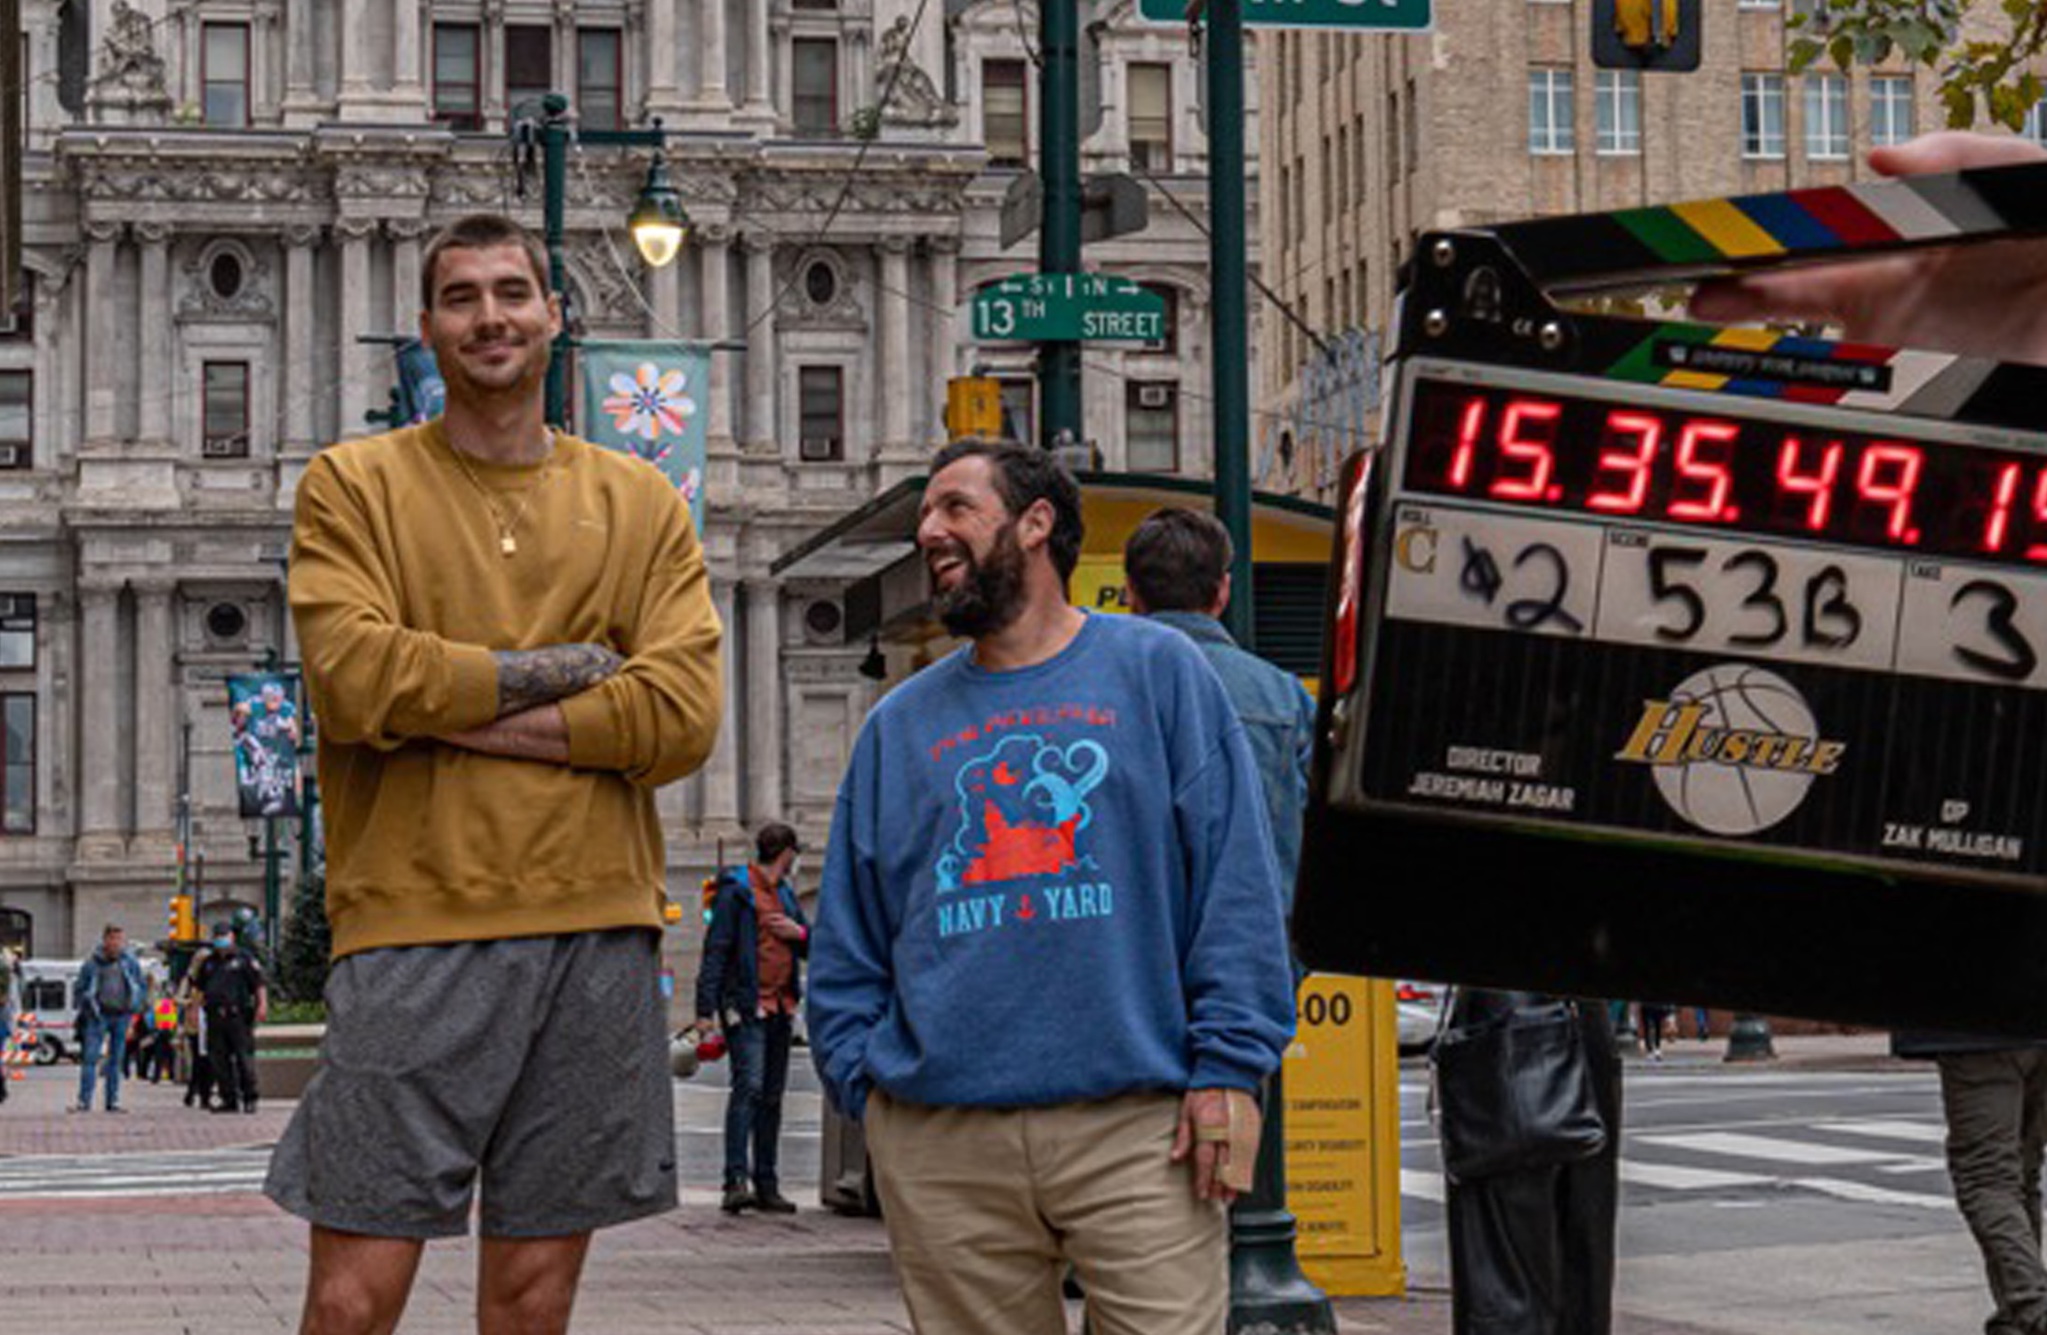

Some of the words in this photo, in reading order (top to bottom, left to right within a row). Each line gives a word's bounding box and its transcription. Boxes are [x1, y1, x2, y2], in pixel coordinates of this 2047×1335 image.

[1082, 311, 1160, 337] STREET
[1395, 527, 1438, 575] C
[1647, 546, 1862, 649] 53B
[1949, 579, 2037, 681] 3
[1446, 745, 1543, 777] DIRECTOR
[1408, 771, 1504, 804] JEREMIAH
[1507, 782, 1576, 812] ZAGAR
[1941, 800, 1969, 823] DP
[1881, 822, 1922, 848] ZAK
[1927, 828, 2022, 861] MULLIGAN
[936, 893, 1006, 938] NAVY
[1043, 882, 1114, 920] YARD
[1297, 992, 1352, 1027] 00
